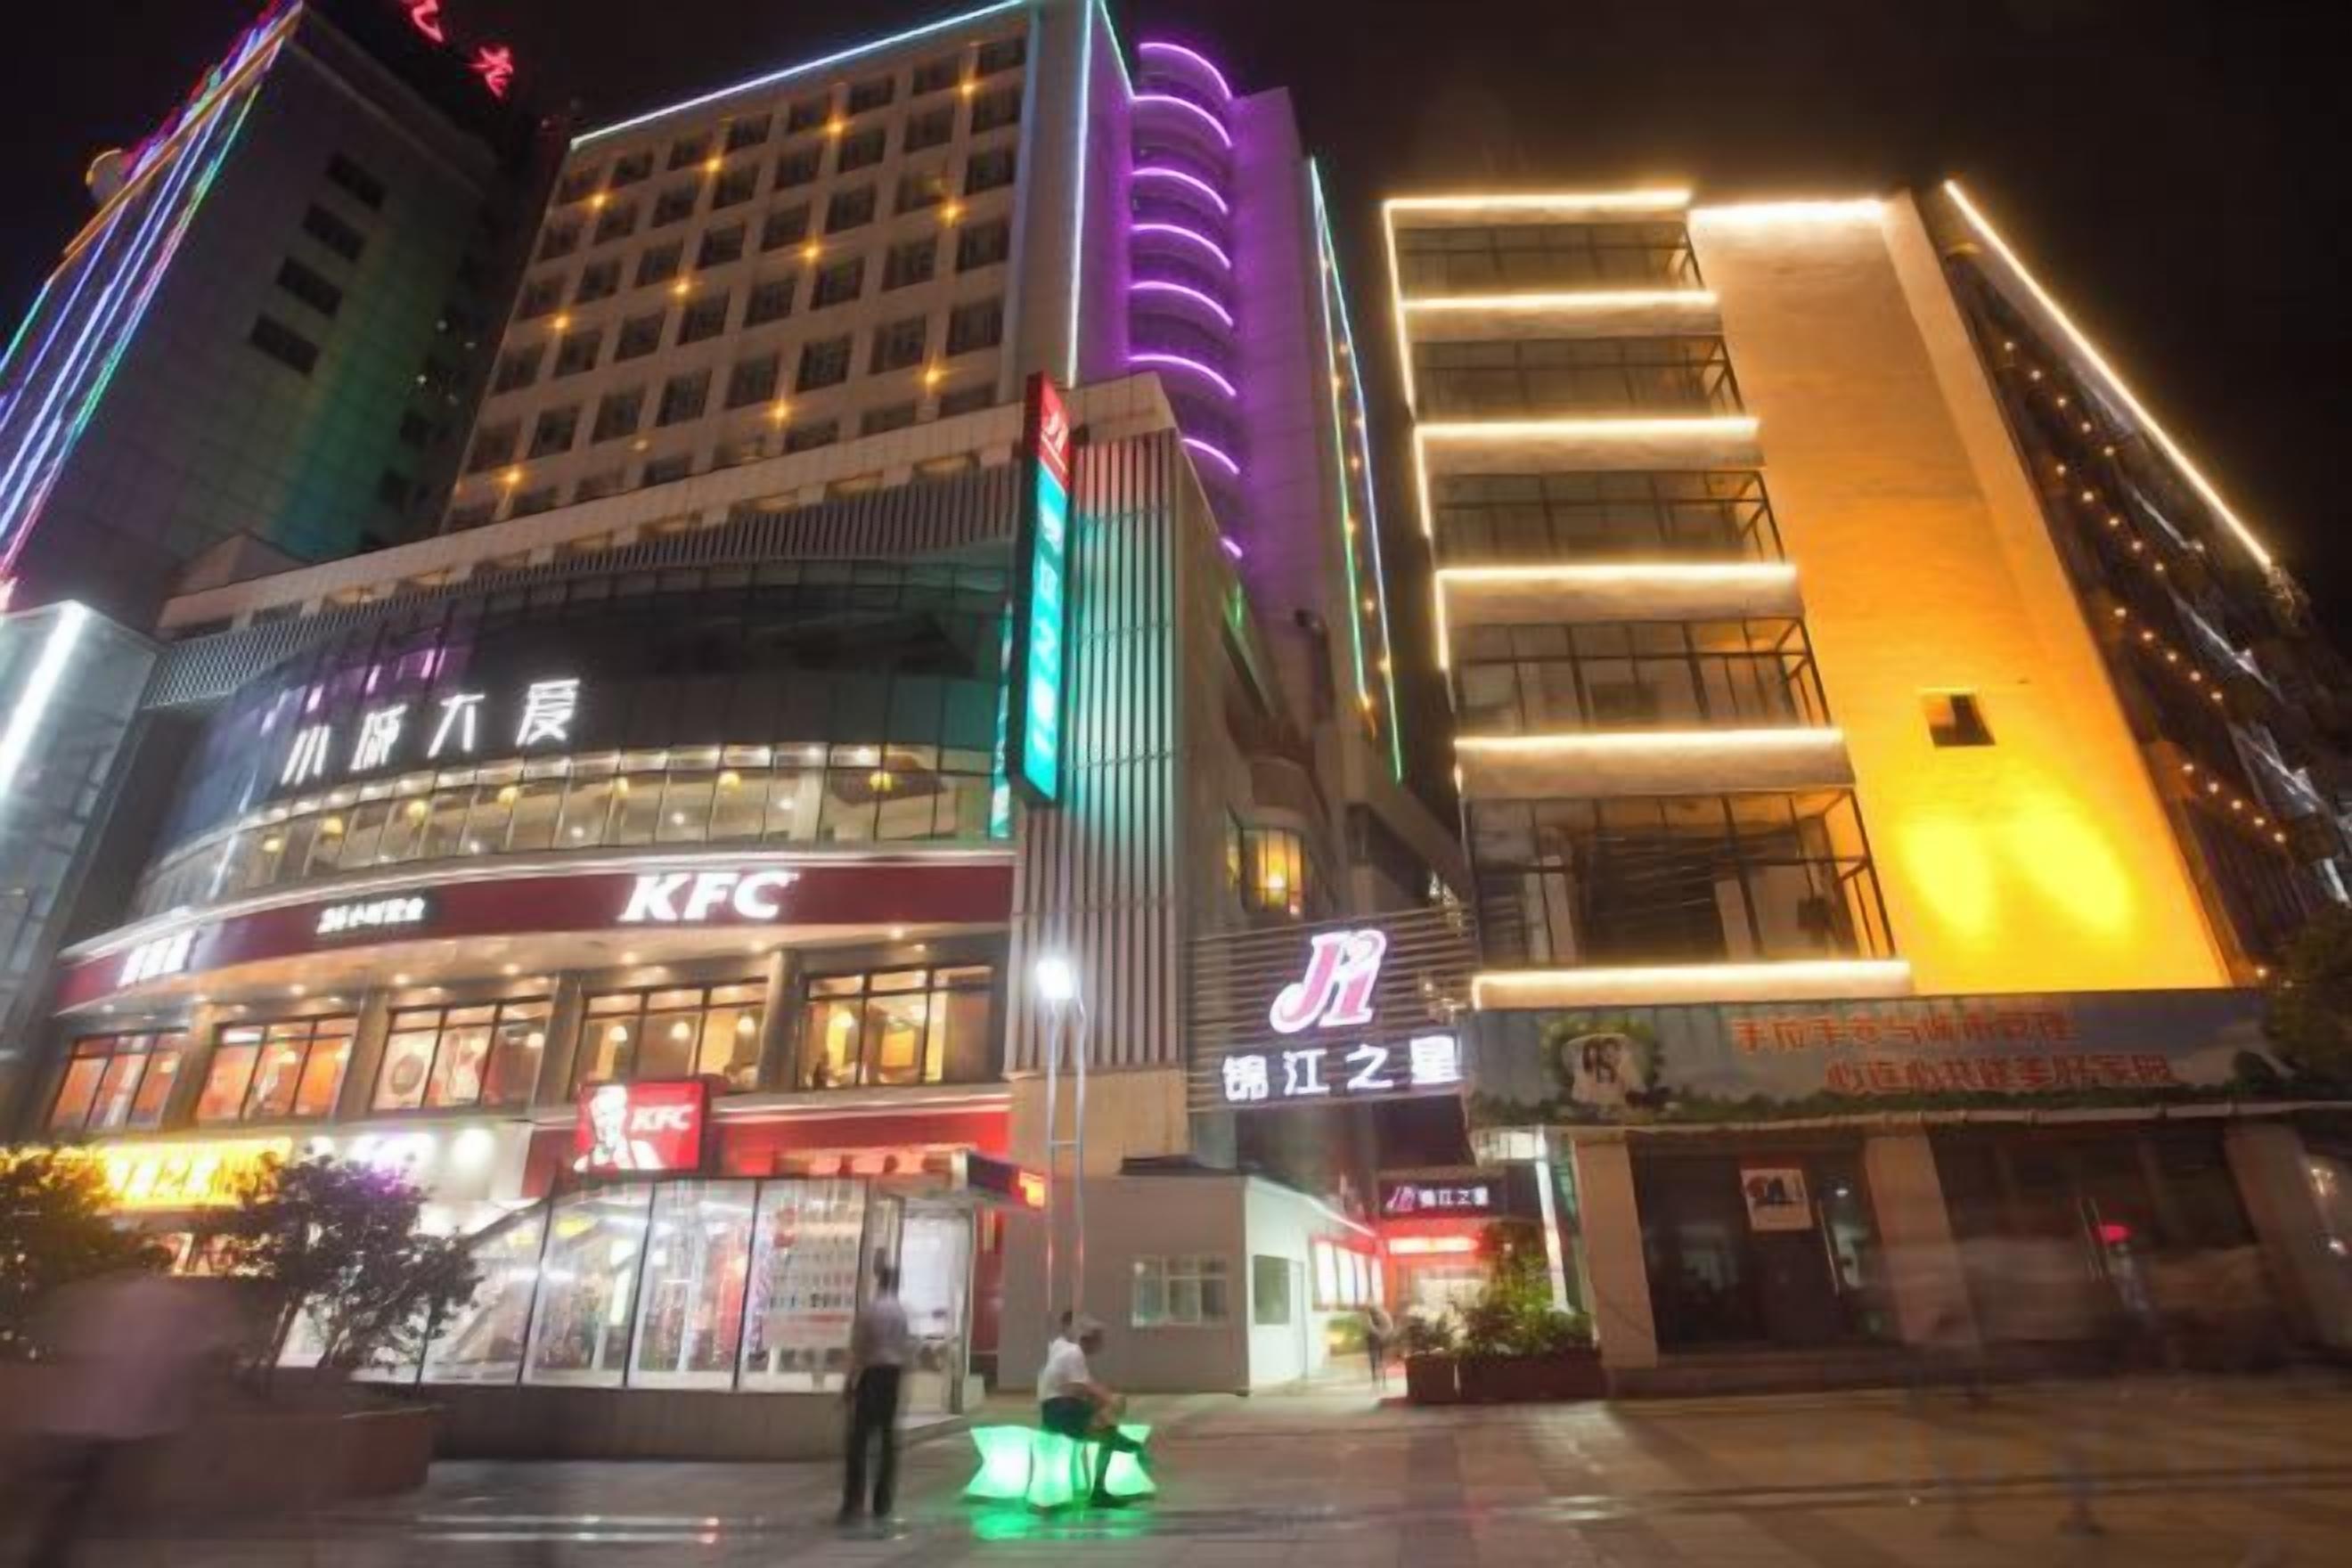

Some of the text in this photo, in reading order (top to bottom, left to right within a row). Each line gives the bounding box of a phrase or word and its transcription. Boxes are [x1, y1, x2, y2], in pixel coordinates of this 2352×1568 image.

[617, 870, 795, 922] KFC
[1223, 1034, 1462, 1101] 锦江之星
[631, 1104, 696, 1132] KFC
